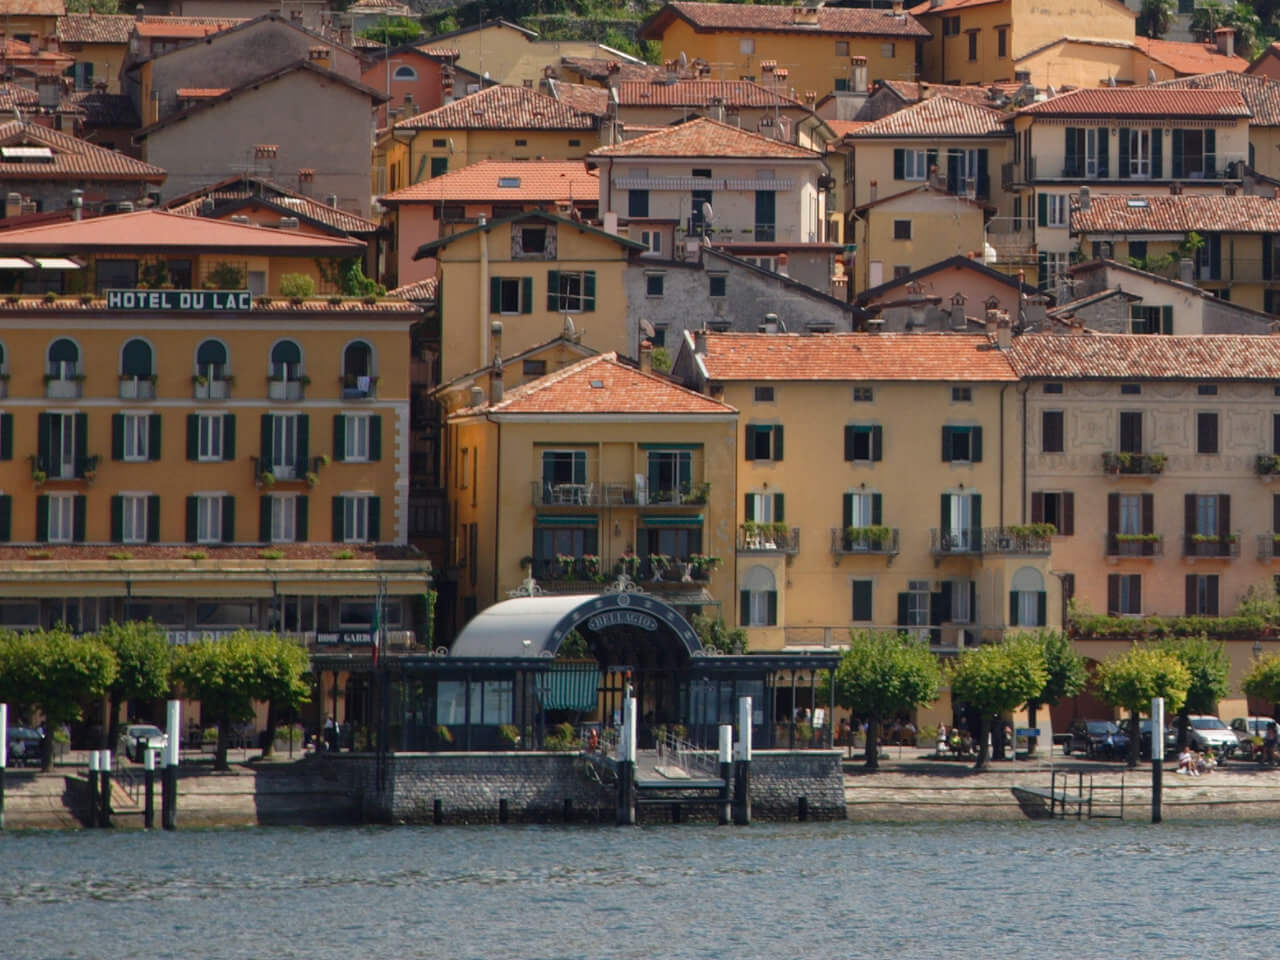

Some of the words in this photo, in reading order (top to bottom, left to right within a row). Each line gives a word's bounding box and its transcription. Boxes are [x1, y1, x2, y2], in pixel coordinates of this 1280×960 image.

[109, 292, 172, 308] HOTEL
[180, 293, 204, 309] DU
[213, 293, 249, 309] LAC
